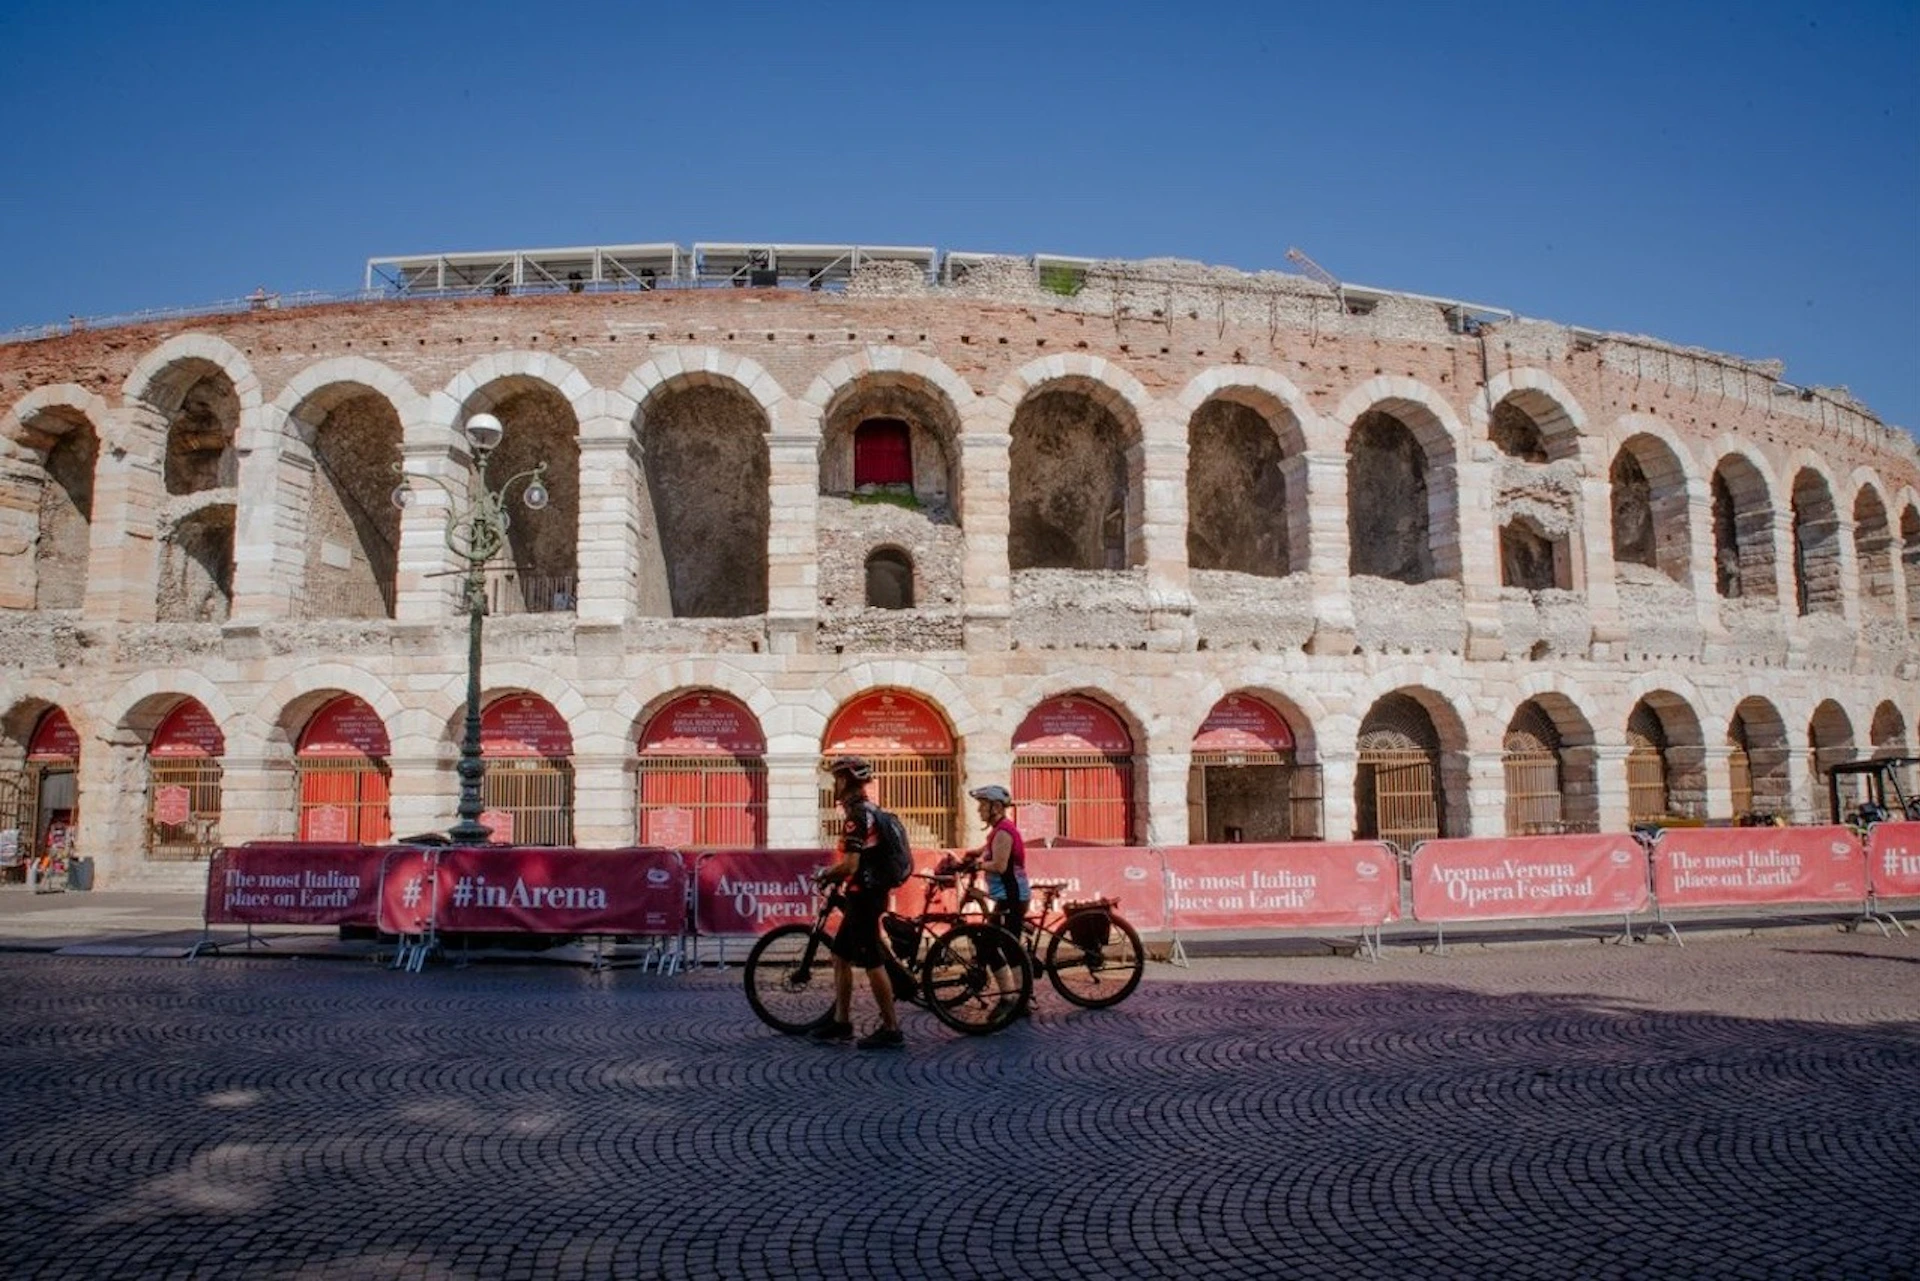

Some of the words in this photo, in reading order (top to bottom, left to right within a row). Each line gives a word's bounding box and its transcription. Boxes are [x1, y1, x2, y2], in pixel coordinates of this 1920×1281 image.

[1669, 851, 1700, 869] The
[1705, 852, 1743, 868] most
[1750, 849, 1801, 867] Italian
[225, 869, 256, 888] The
[260, 871, 300, 888] most
[305, 870, 360, 889] Italian
[1200, 872, 1247, 890] most
[1252, 870, 1317, 889] Italian
[1429, 863, 1490, 884] Arena
[1503, 860, 1575, 880] Verona
[1674, 870, 1718, 893] place
[1722, 874, 1743, 886] on
[453, 875, 608, 909] #inArena
[714, 875, 782, 896] Arena
[1447, 877, 1514, 908] Opera
[1517, 876, 1593, 899] Festival
[224, 889, 270, 911] place
[275, 893, 296, 908] on
[734, 892, 808, 924] Opera
[1218, 896, 1244, 909] on
